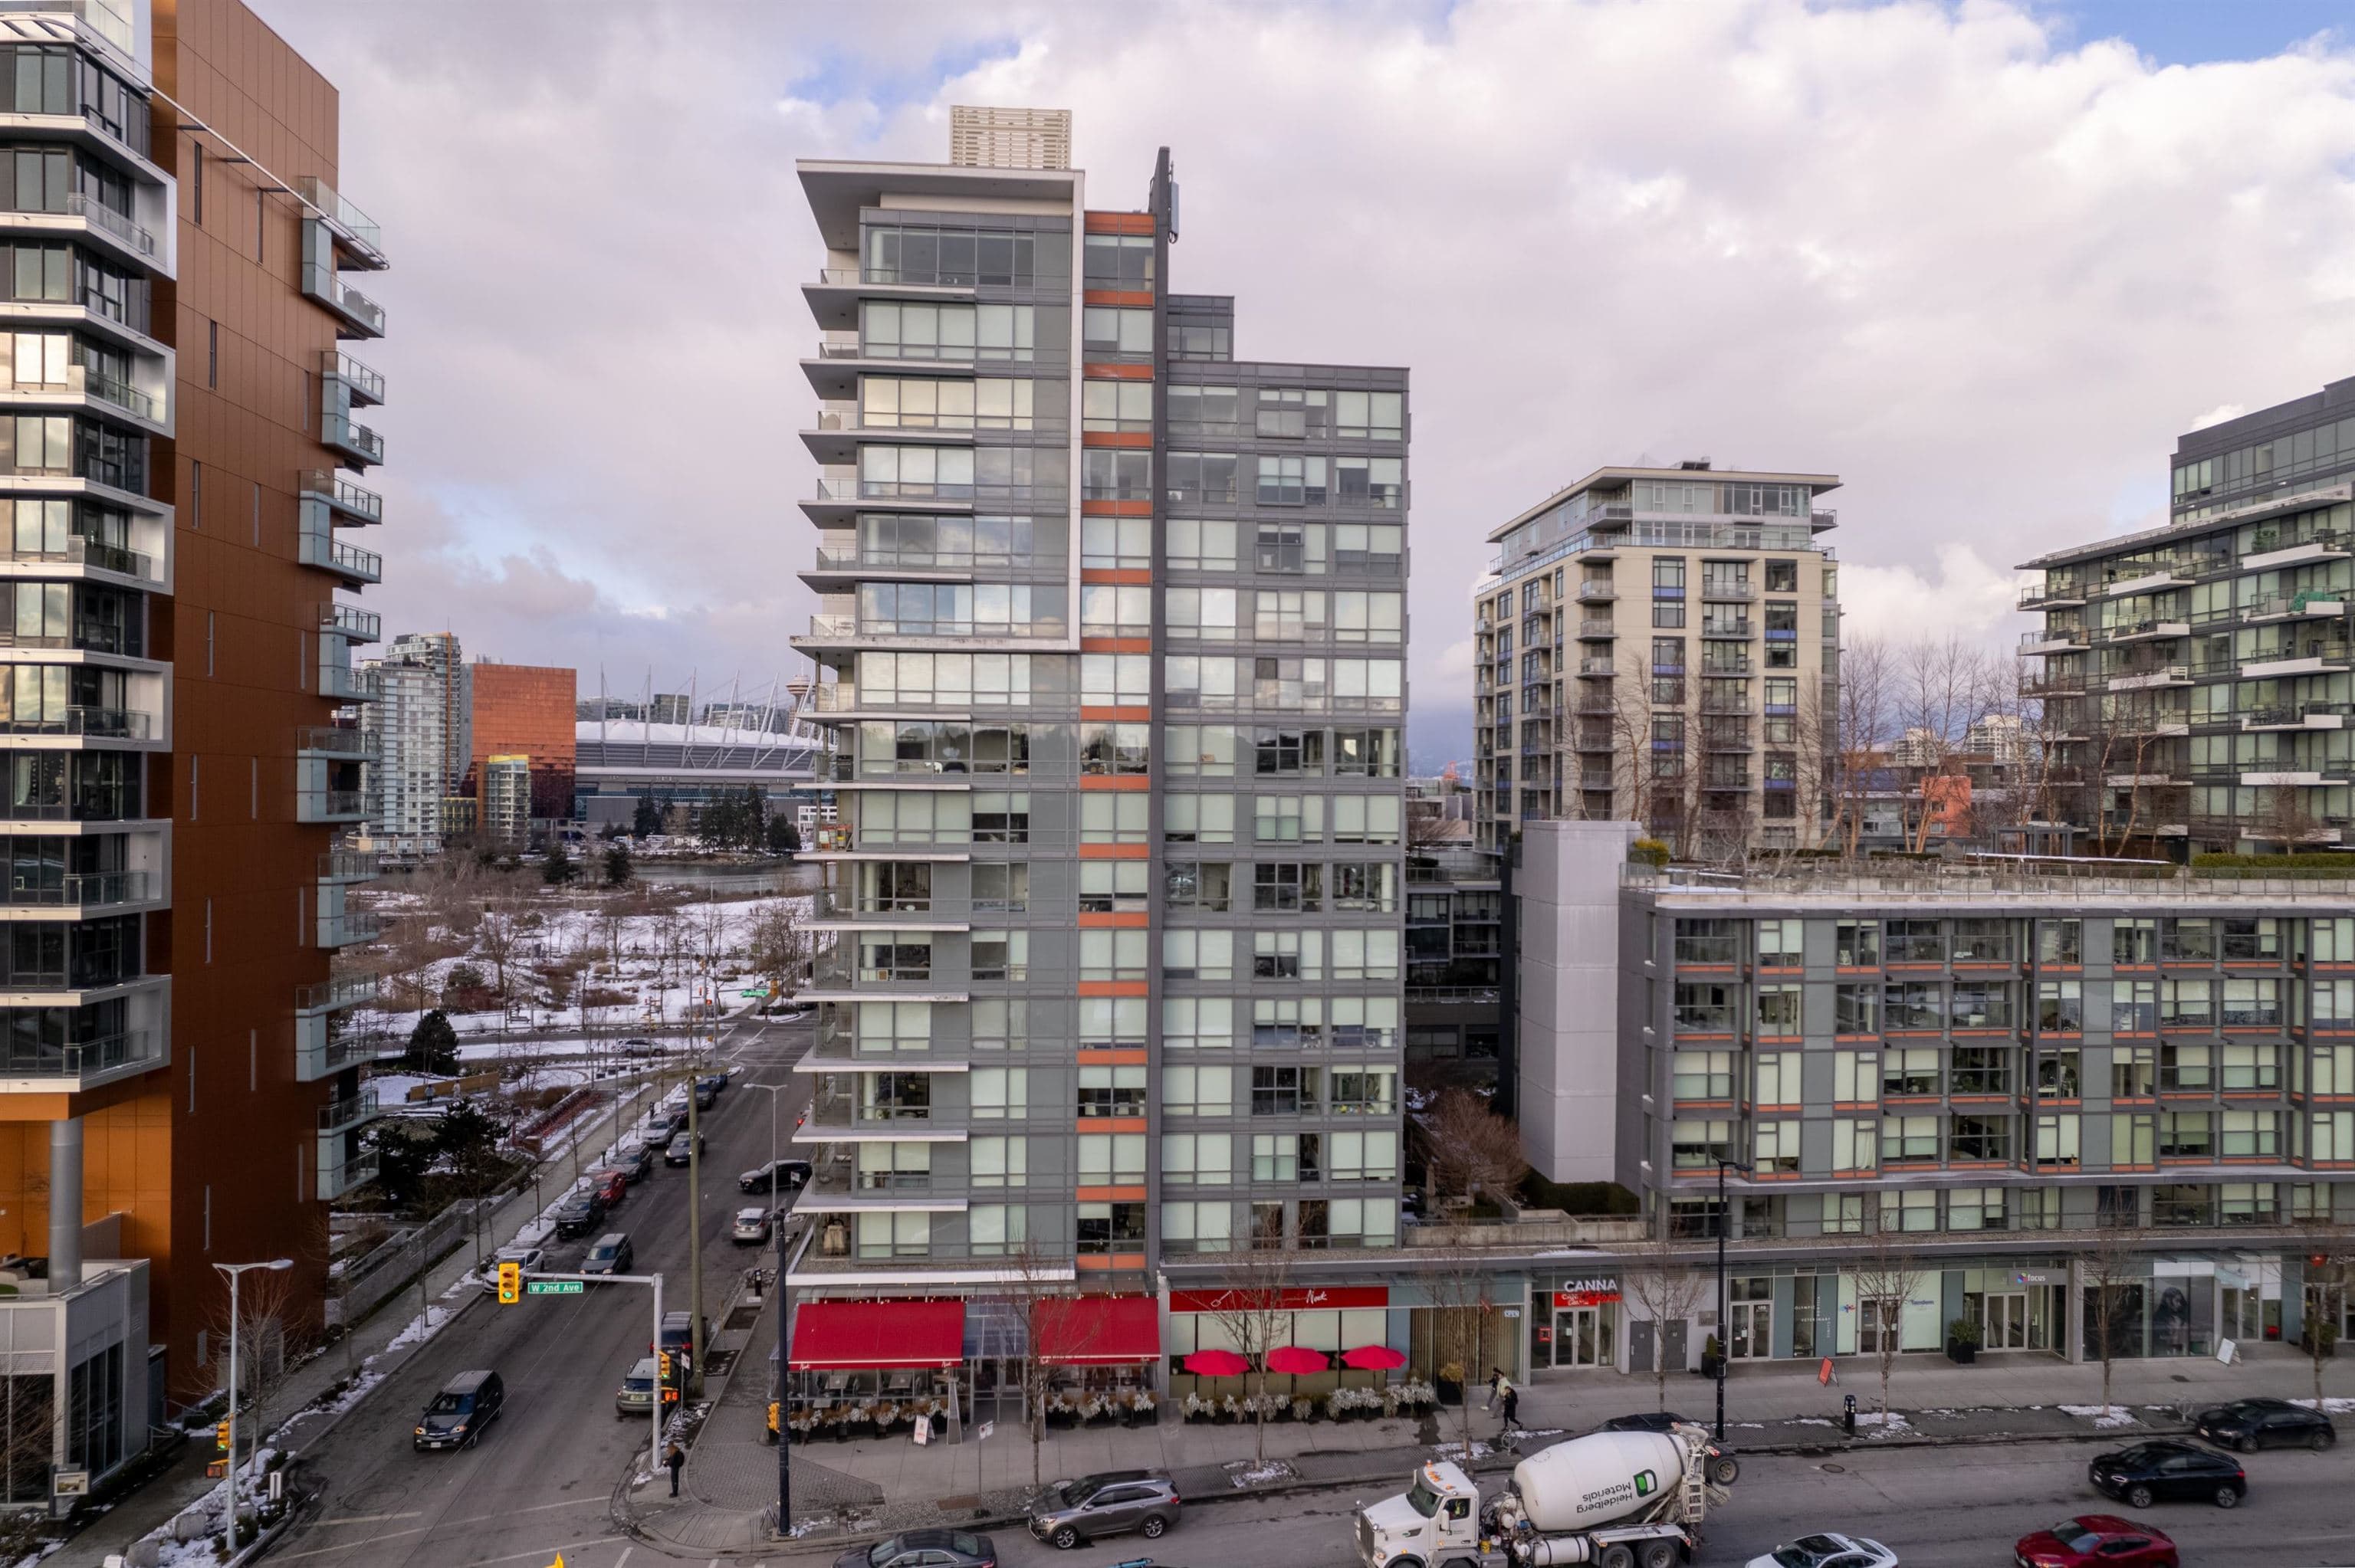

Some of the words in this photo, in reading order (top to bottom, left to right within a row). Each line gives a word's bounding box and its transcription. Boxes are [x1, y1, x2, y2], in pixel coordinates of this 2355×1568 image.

[531, 1284, 540, 1292] W
[544, 1284, 560, 1292] 2nd
[563, 1284, 580, 1292] Ave
[1564, 1278, 1618, 1293] CANNA
[1582, 1482, 1631, 1502] Materials
[1576, 1493, 1633, 1513] Heidelberg
